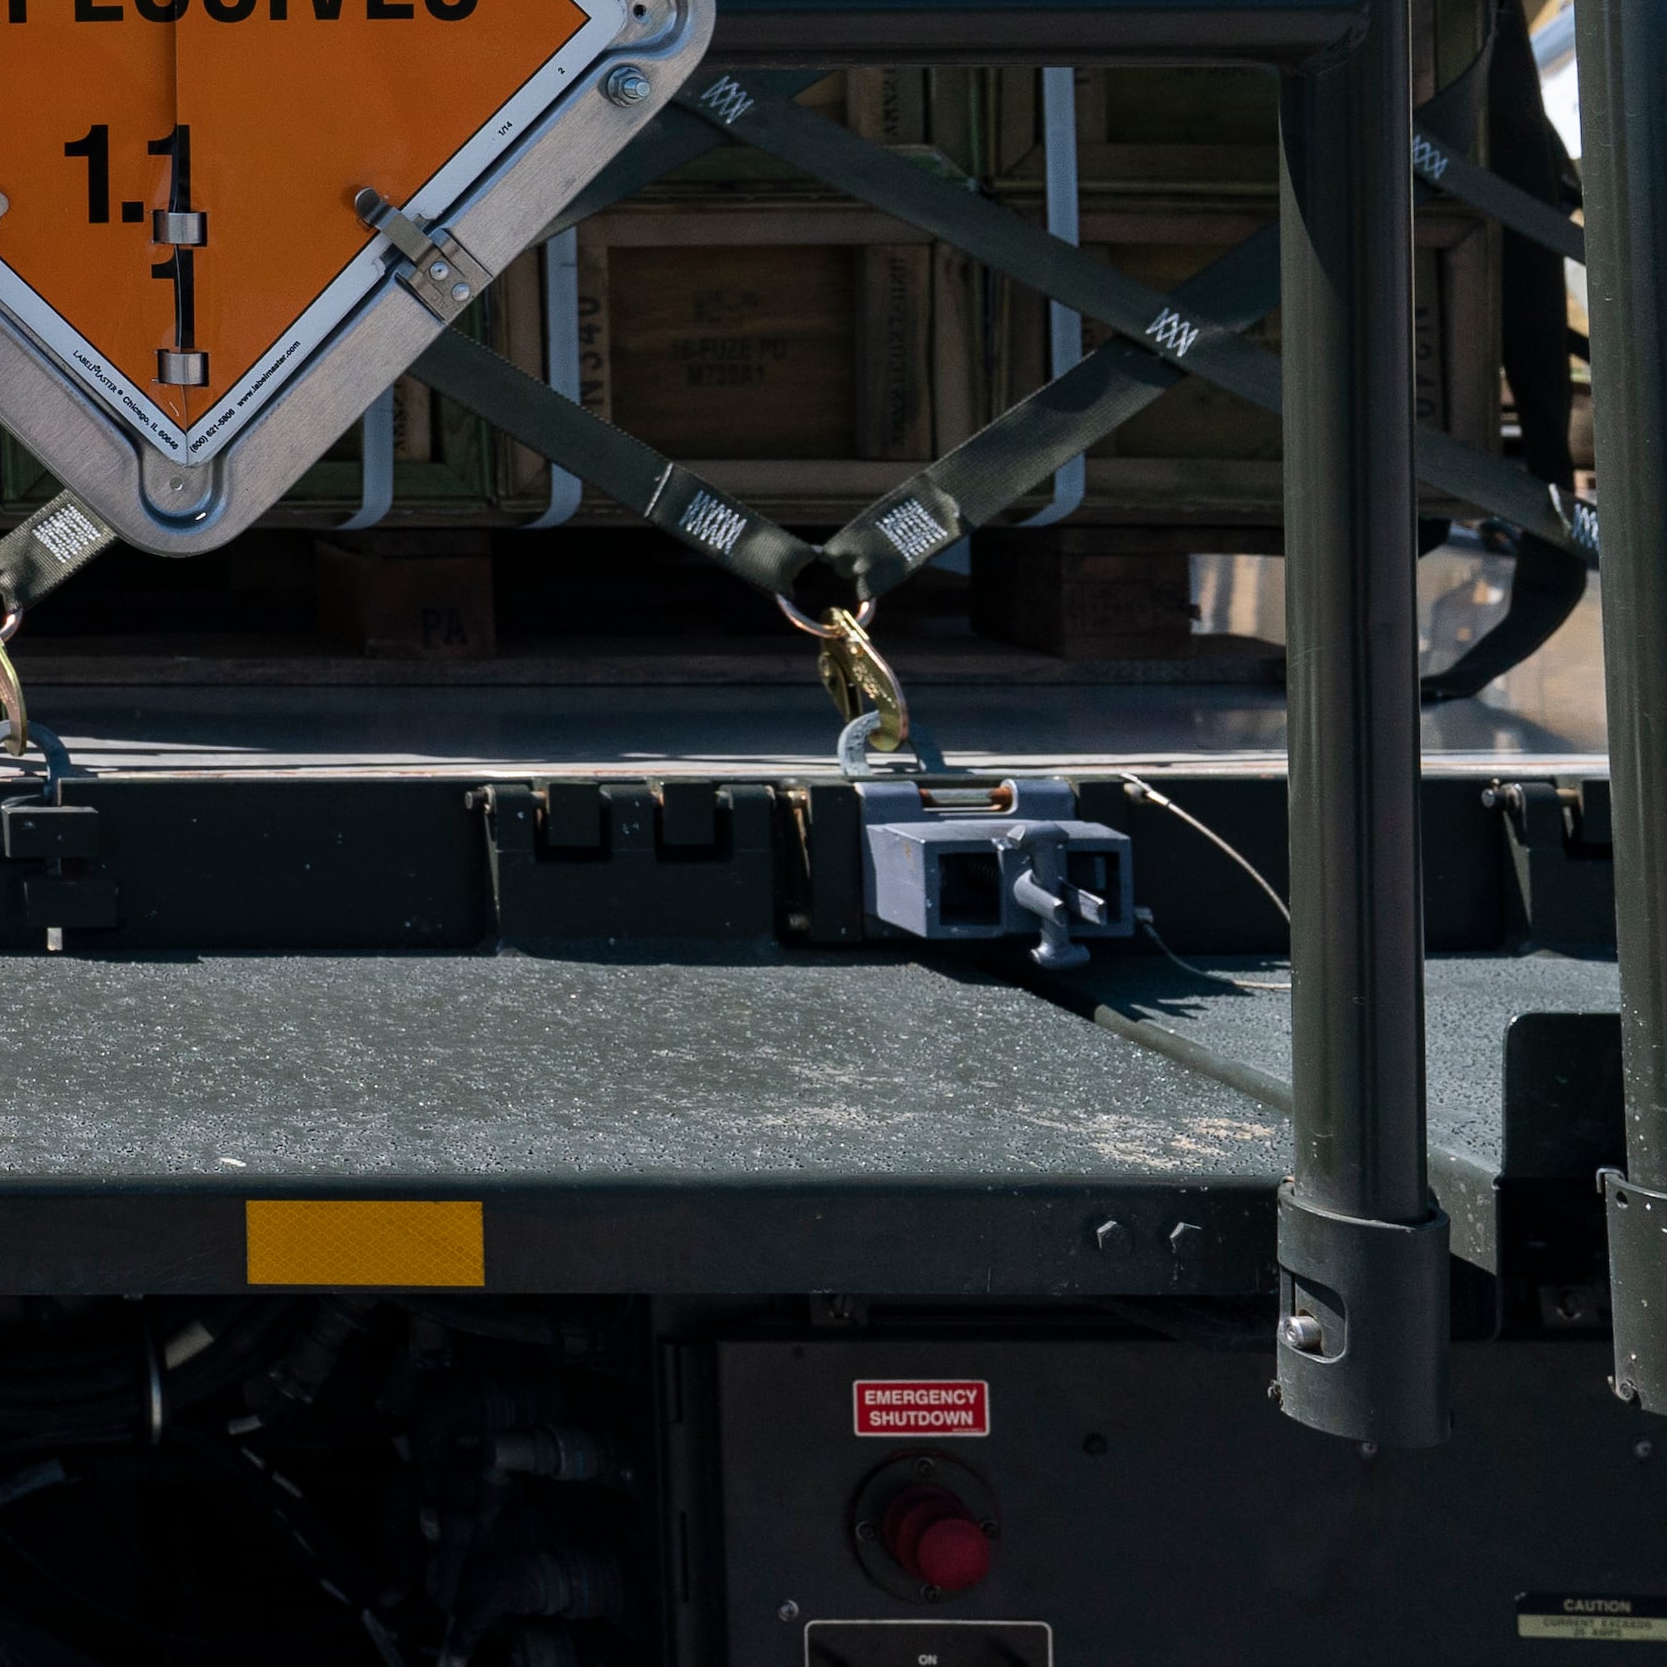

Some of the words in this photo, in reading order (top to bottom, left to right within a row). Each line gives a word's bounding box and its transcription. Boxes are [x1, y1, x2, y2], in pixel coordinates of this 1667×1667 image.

[64, 124, 192, 224] 1.1
[72, 349, 117, 394] LABELMASTER
[122, 395, 151, 426] Chicago,
[189, 434, 210, 454] (800)
[236, 340, 302, 408] www.labelmaster.com
[864, 1389, 978, 1406] EMERGENCY
[869, 1410, 974, 1427] SHUTDOWN
[1562, 1597, 1633, 1615] CAUTION
[917, 1654, 938, 1666] ON
